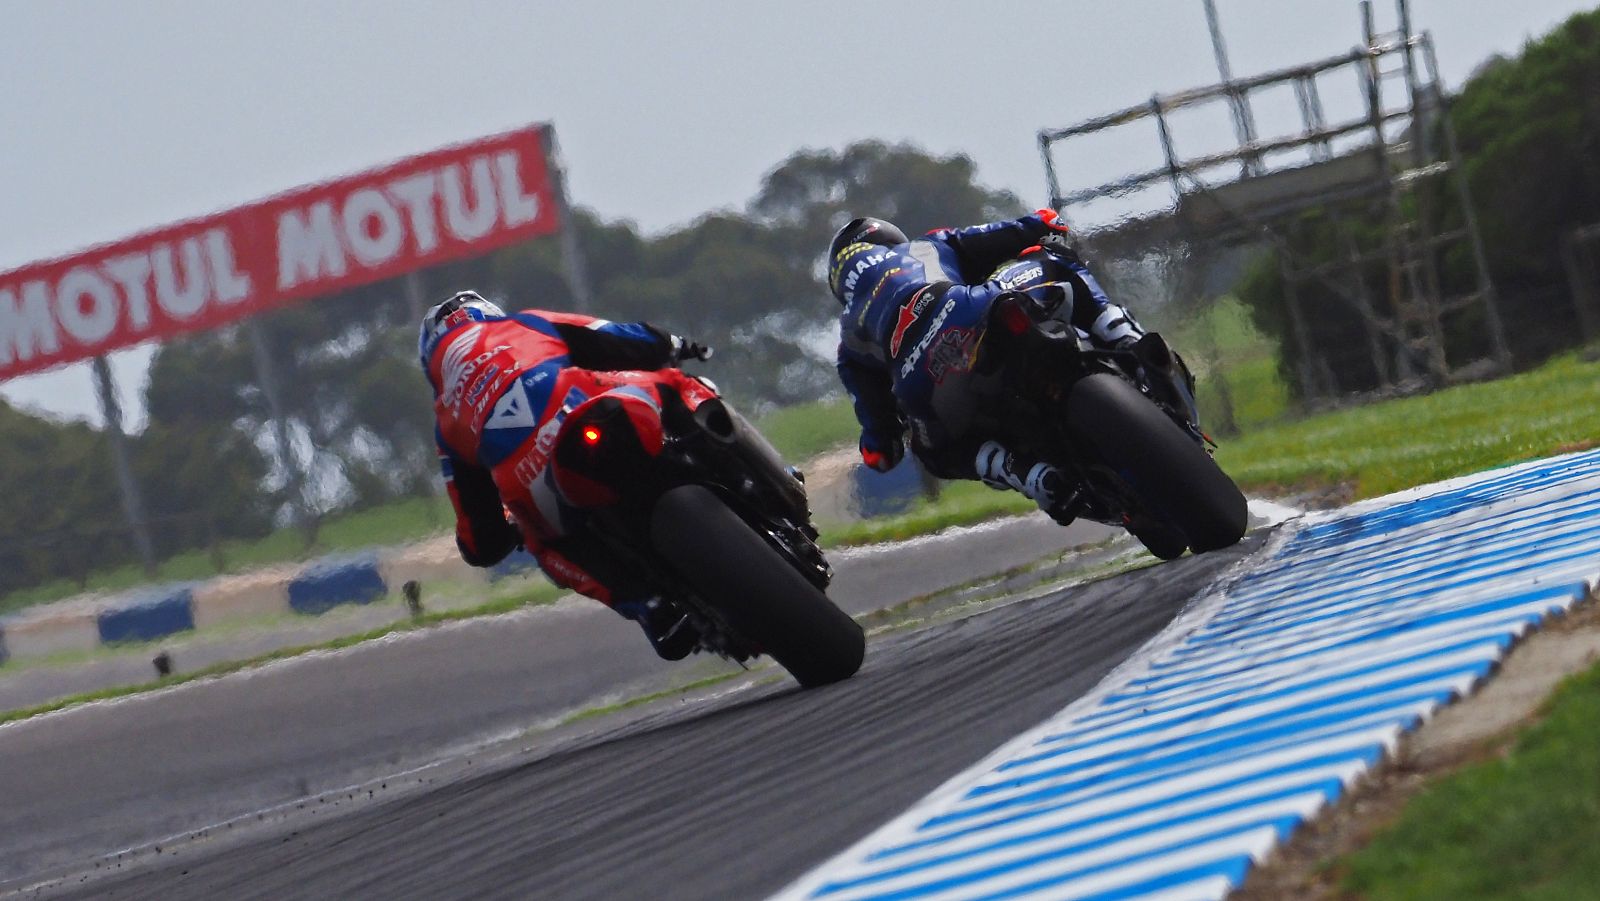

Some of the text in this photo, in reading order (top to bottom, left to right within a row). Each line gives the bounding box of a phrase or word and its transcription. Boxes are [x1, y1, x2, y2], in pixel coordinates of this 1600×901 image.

[277, 150, 539, 290] MOTUL
[0, 228, 250, 364] MOTUL
[843, 250, 898, 314] YAMAHA
[901, 298, 956, 379] alpinestars
[451, 345, 513, 420] HONDA
